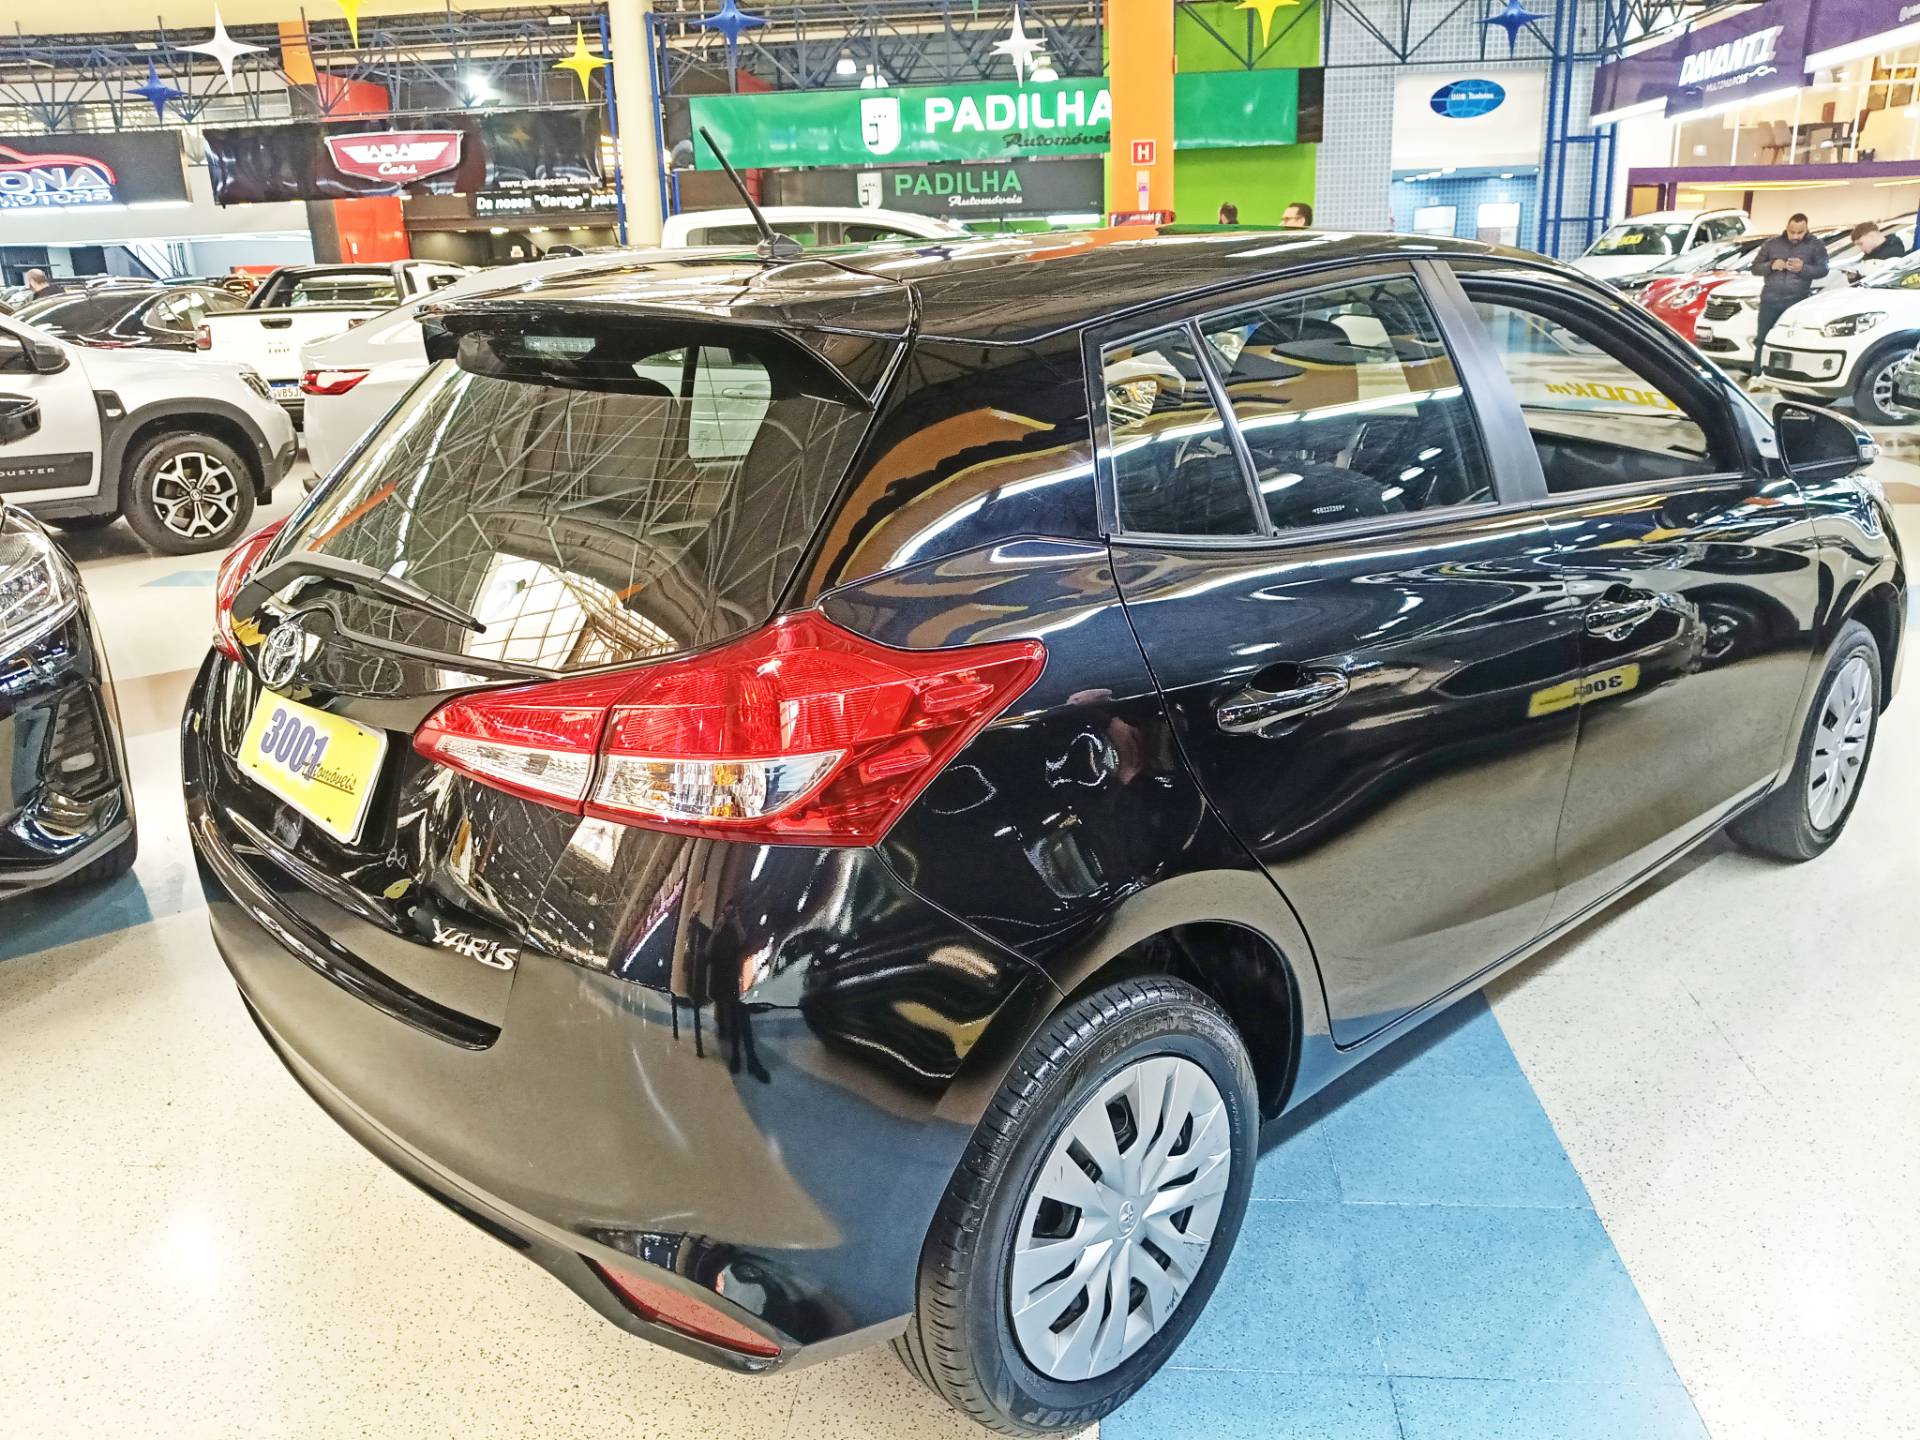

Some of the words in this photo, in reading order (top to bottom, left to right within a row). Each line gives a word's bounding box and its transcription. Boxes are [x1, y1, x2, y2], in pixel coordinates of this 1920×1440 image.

[1678, 26, 1784, 87] DAVANTI
[925, 90, 1112, 133] PADILHA
[1002, 131, 1111, 148] Automóvei
[378, 162, 417, 175] Cars
[895, 170, 1022, 196] PADILHA
[948, 194, 1023, 207] Automóveis
[261, 708, 329, 780] 3001
[432, 918, 519, 970] YARIS
